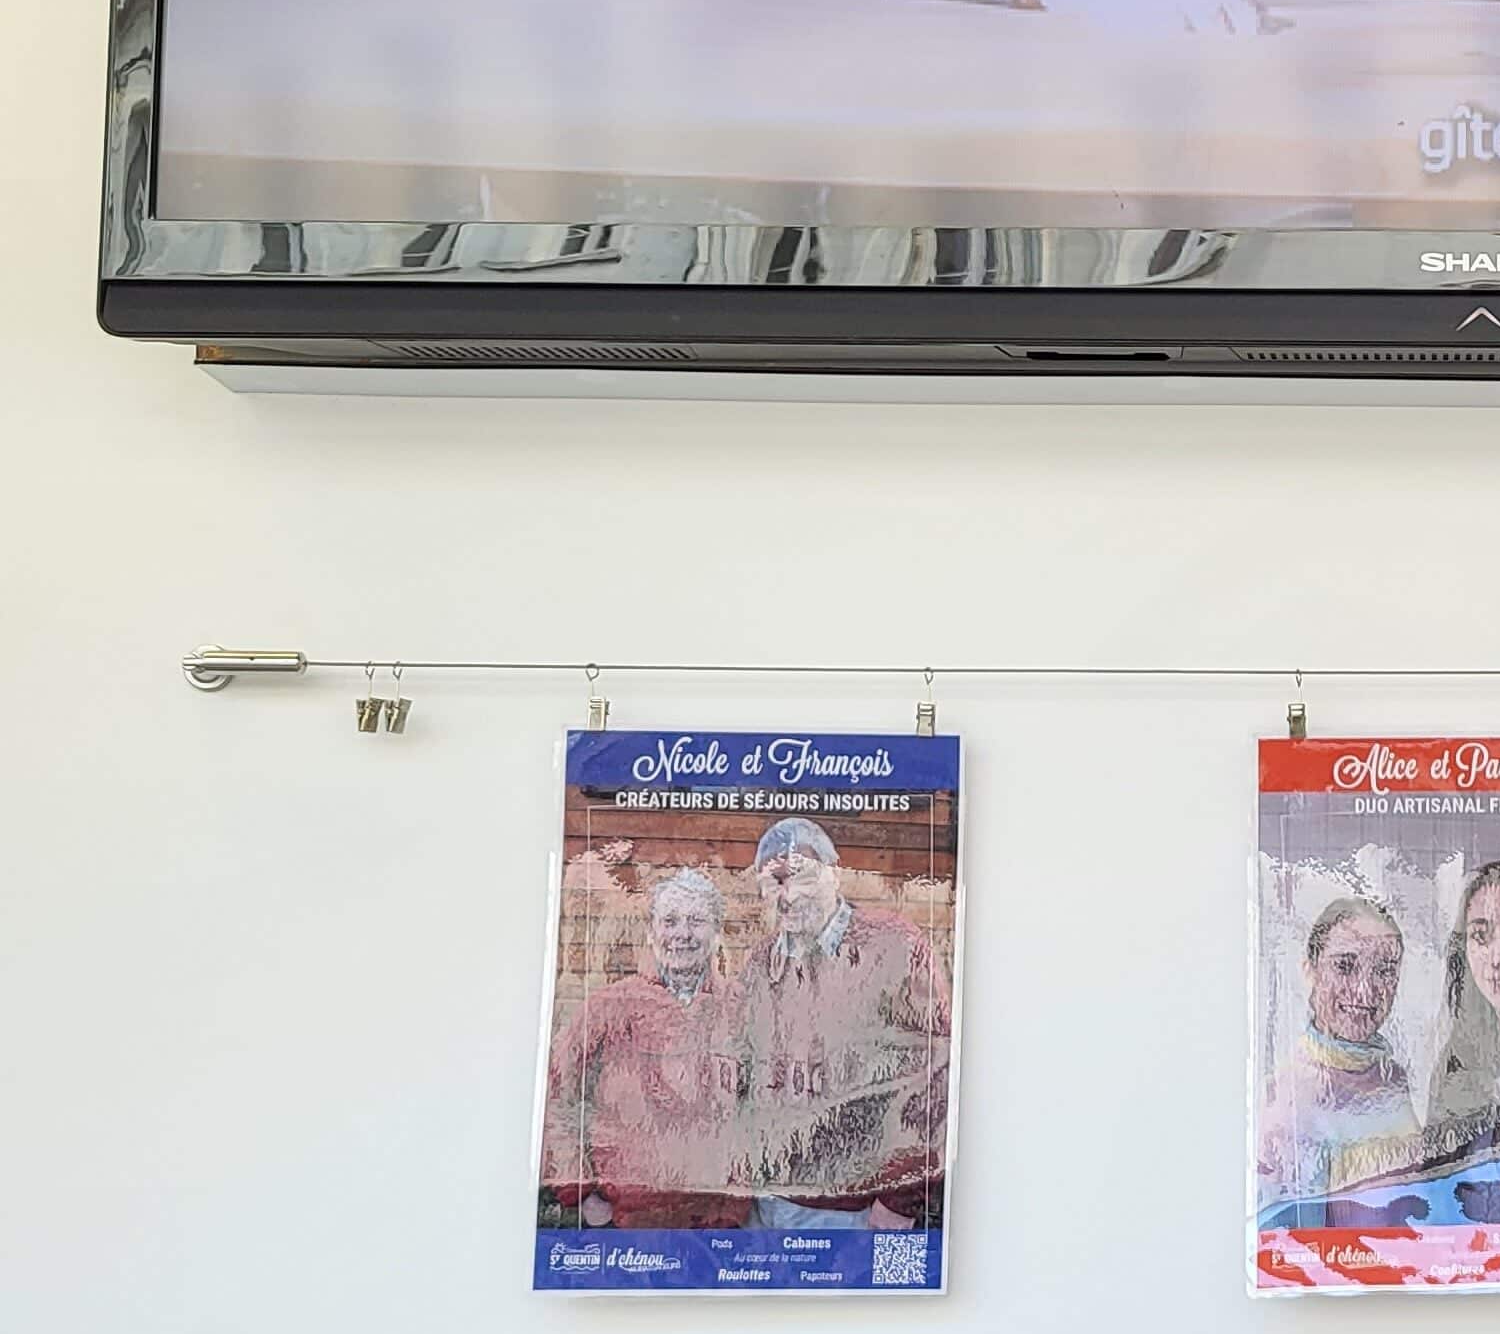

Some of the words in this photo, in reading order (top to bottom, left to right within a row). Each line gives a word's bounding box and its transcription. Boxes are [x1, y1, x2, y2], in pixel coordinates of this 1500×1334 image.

[632, 737, 729, 782] Nicole
[741, 745, 763, 776] et
[767, 737, 894, 784] François
[1333, 742, 1418, 795] Alice
[1430, 745, 1452, 780] et
[615, 788, 713, 809] CRÉATEURS
[718, 792, 738, 809] DE
[743, 788, 820, 810] SÉJOURS
[824, 793, 911, 812] INSOLITES
[1355, 796, 1388, 814] DUO
[1393, 796, 1485, 814] ARTISANAL
[783, 1236, 832, 1249] Cabanes
[718, 1268, 771, 1281] Roulottes
